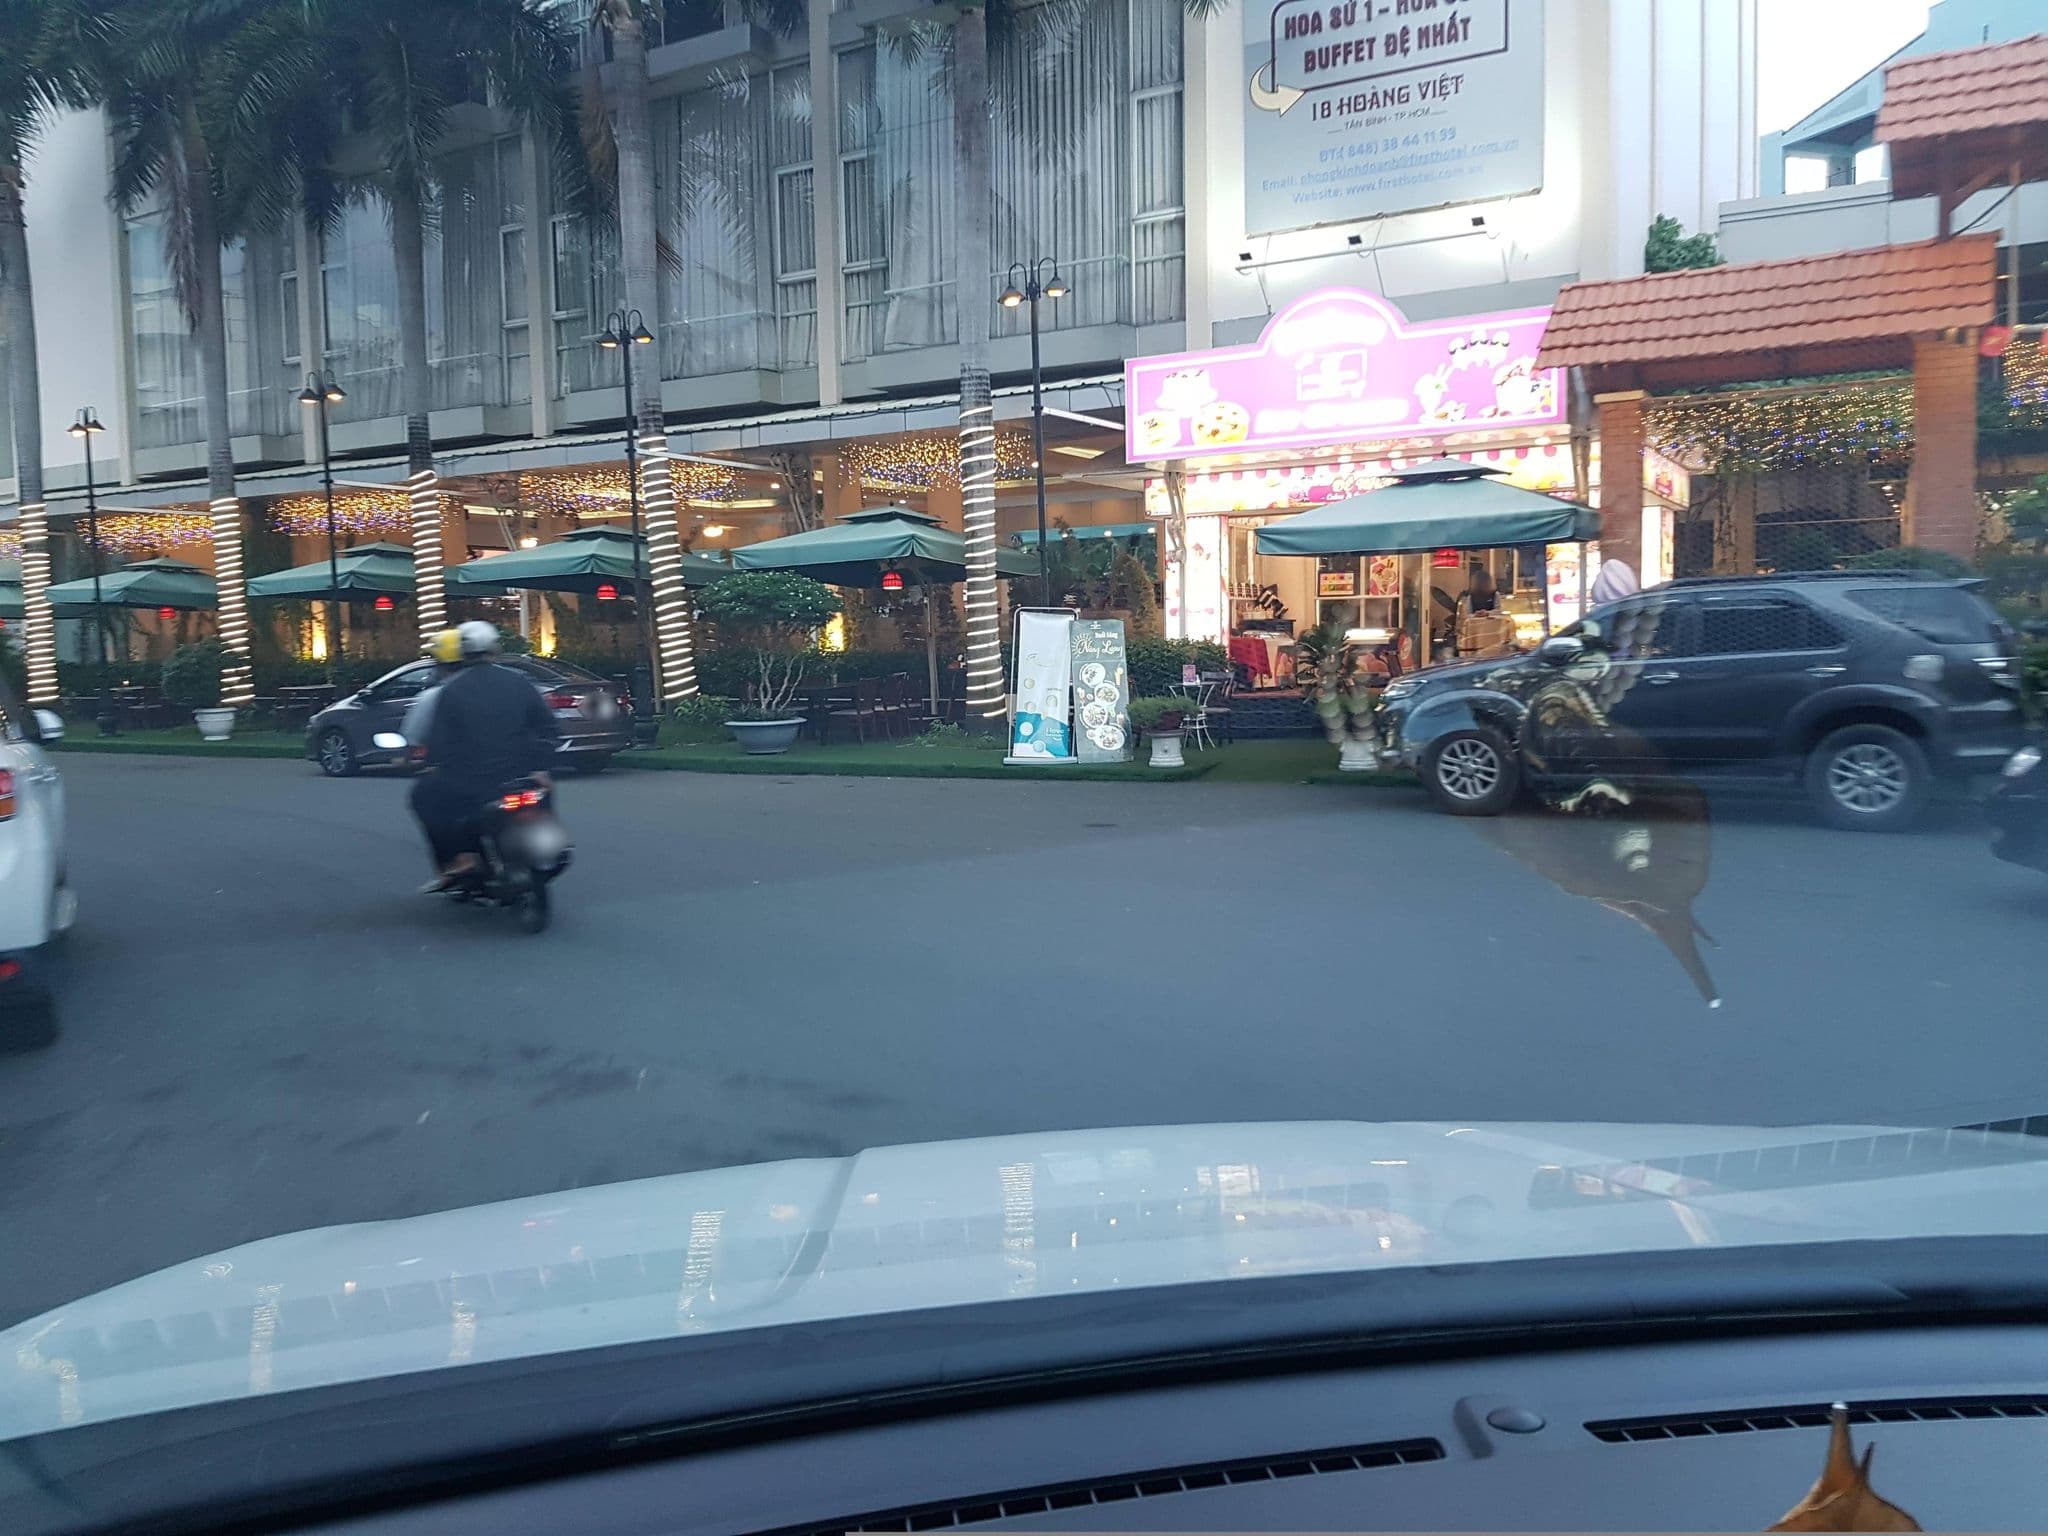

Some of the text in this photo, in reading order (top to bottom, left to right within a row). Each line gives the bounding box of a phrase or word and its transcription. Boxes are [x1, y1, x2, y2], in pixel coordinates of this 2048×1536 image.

[1284, 12, 1323, 40] HOA
[1364, 2, 1373, 22] 1
[1304, 10, 1471, 73] BUFFET ĐỆ NHẤT
[1312, 72, 1465, 121] 18 HOÀNG VIỆT
[1402, 132, 1420, 148] 44
[1424, 129, 1437, 144] 11
